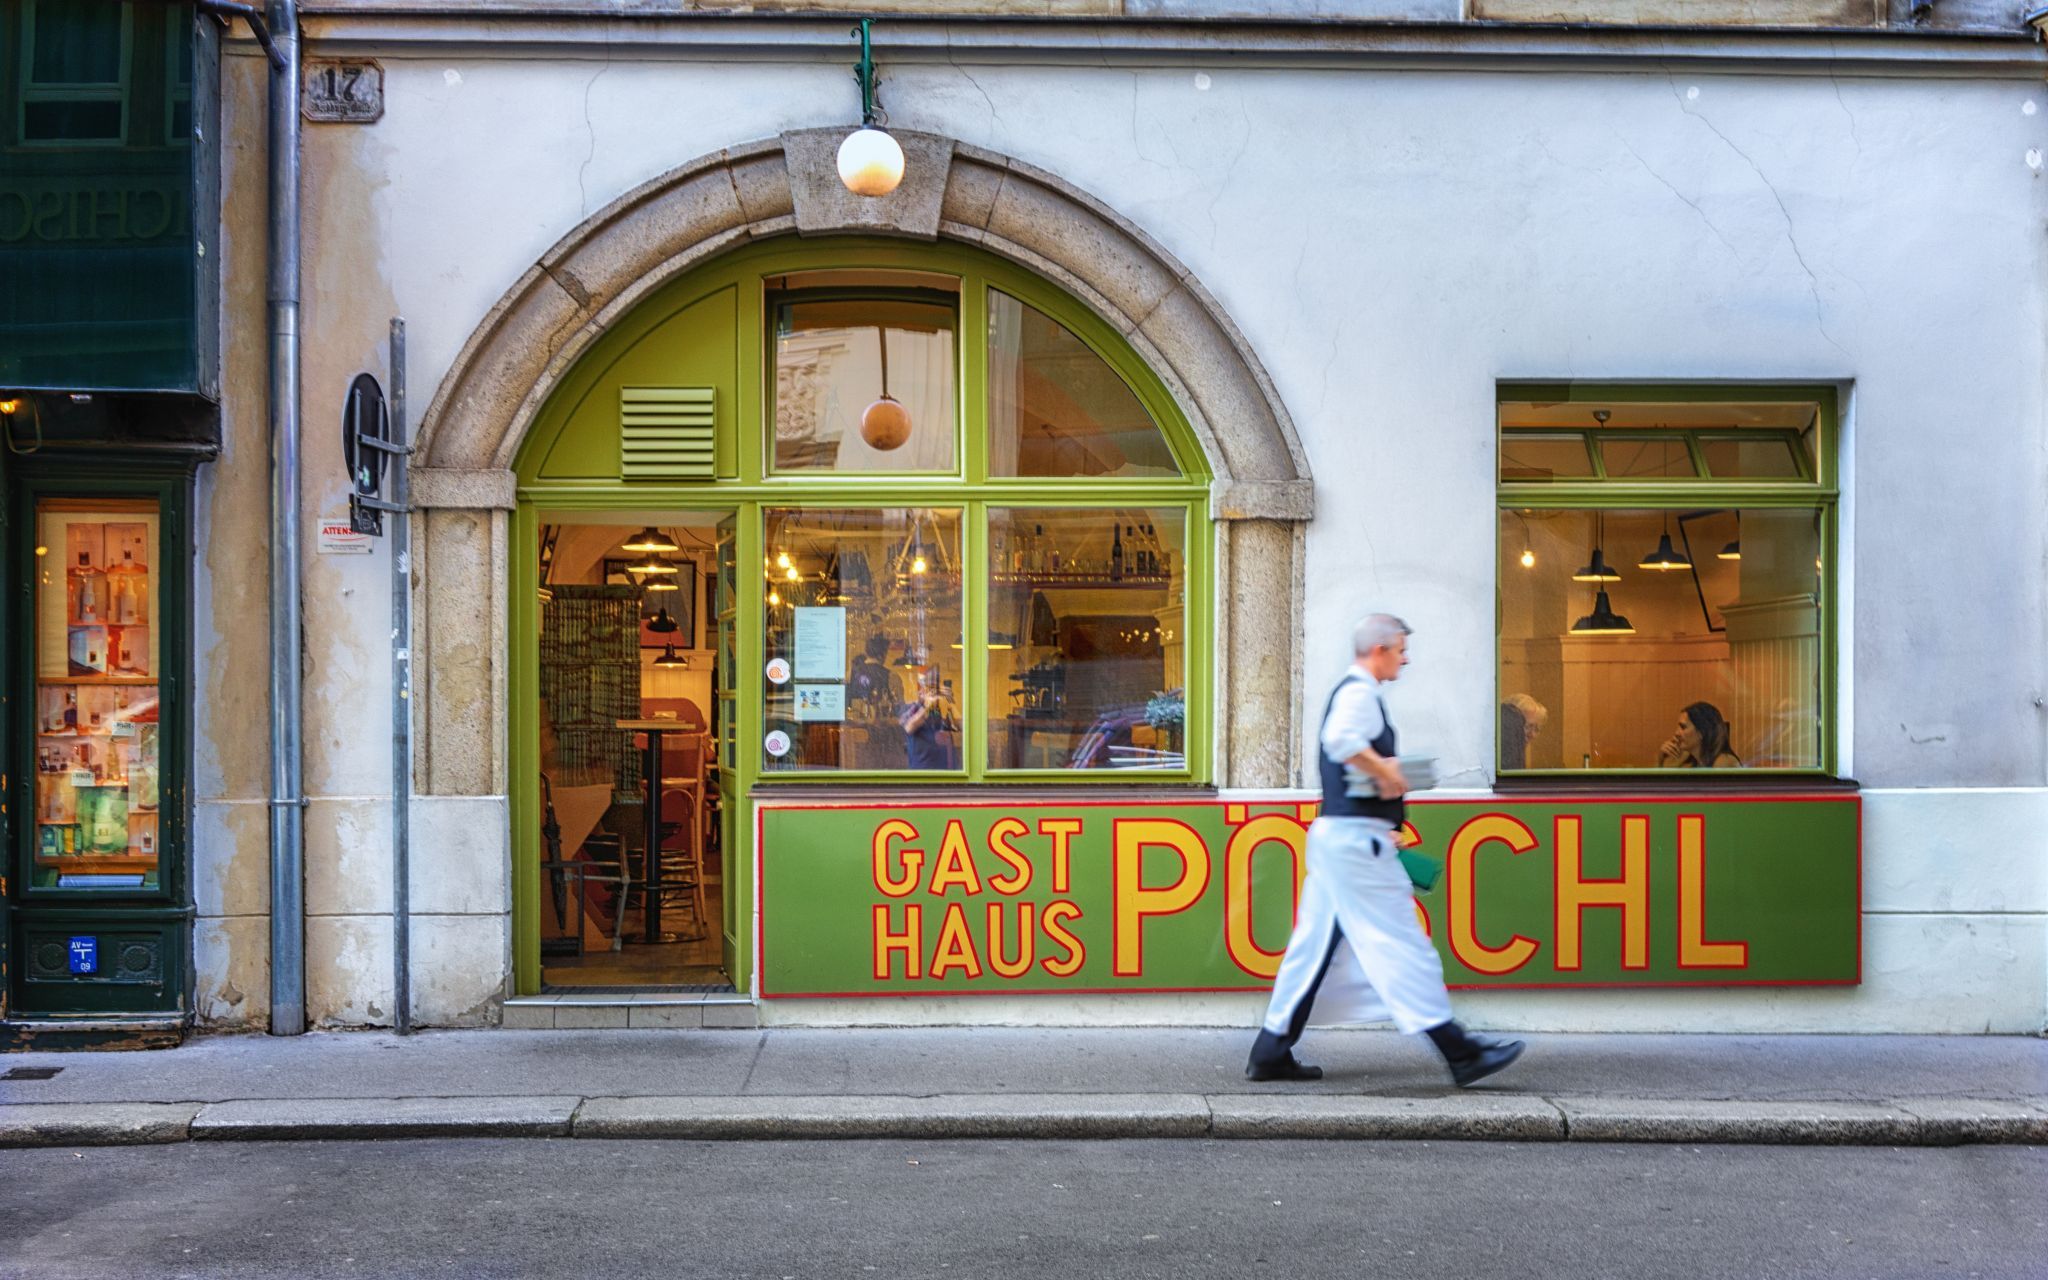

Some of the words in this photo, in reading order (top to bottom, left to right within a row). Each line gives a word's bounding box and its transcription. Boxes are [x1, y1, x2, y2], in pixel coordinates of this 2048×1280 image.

[324, 68, 361, 101] 17
[322, 526, 362, 535] ATTENS
[872, 817, 1083, 897] GAST
[1112, 804, 1748, 978] PÖCHL
[71, 941, 81, 949] AV
[872, 900, 1087, 980] HAUS
[80, 962, 90, 970] 09
